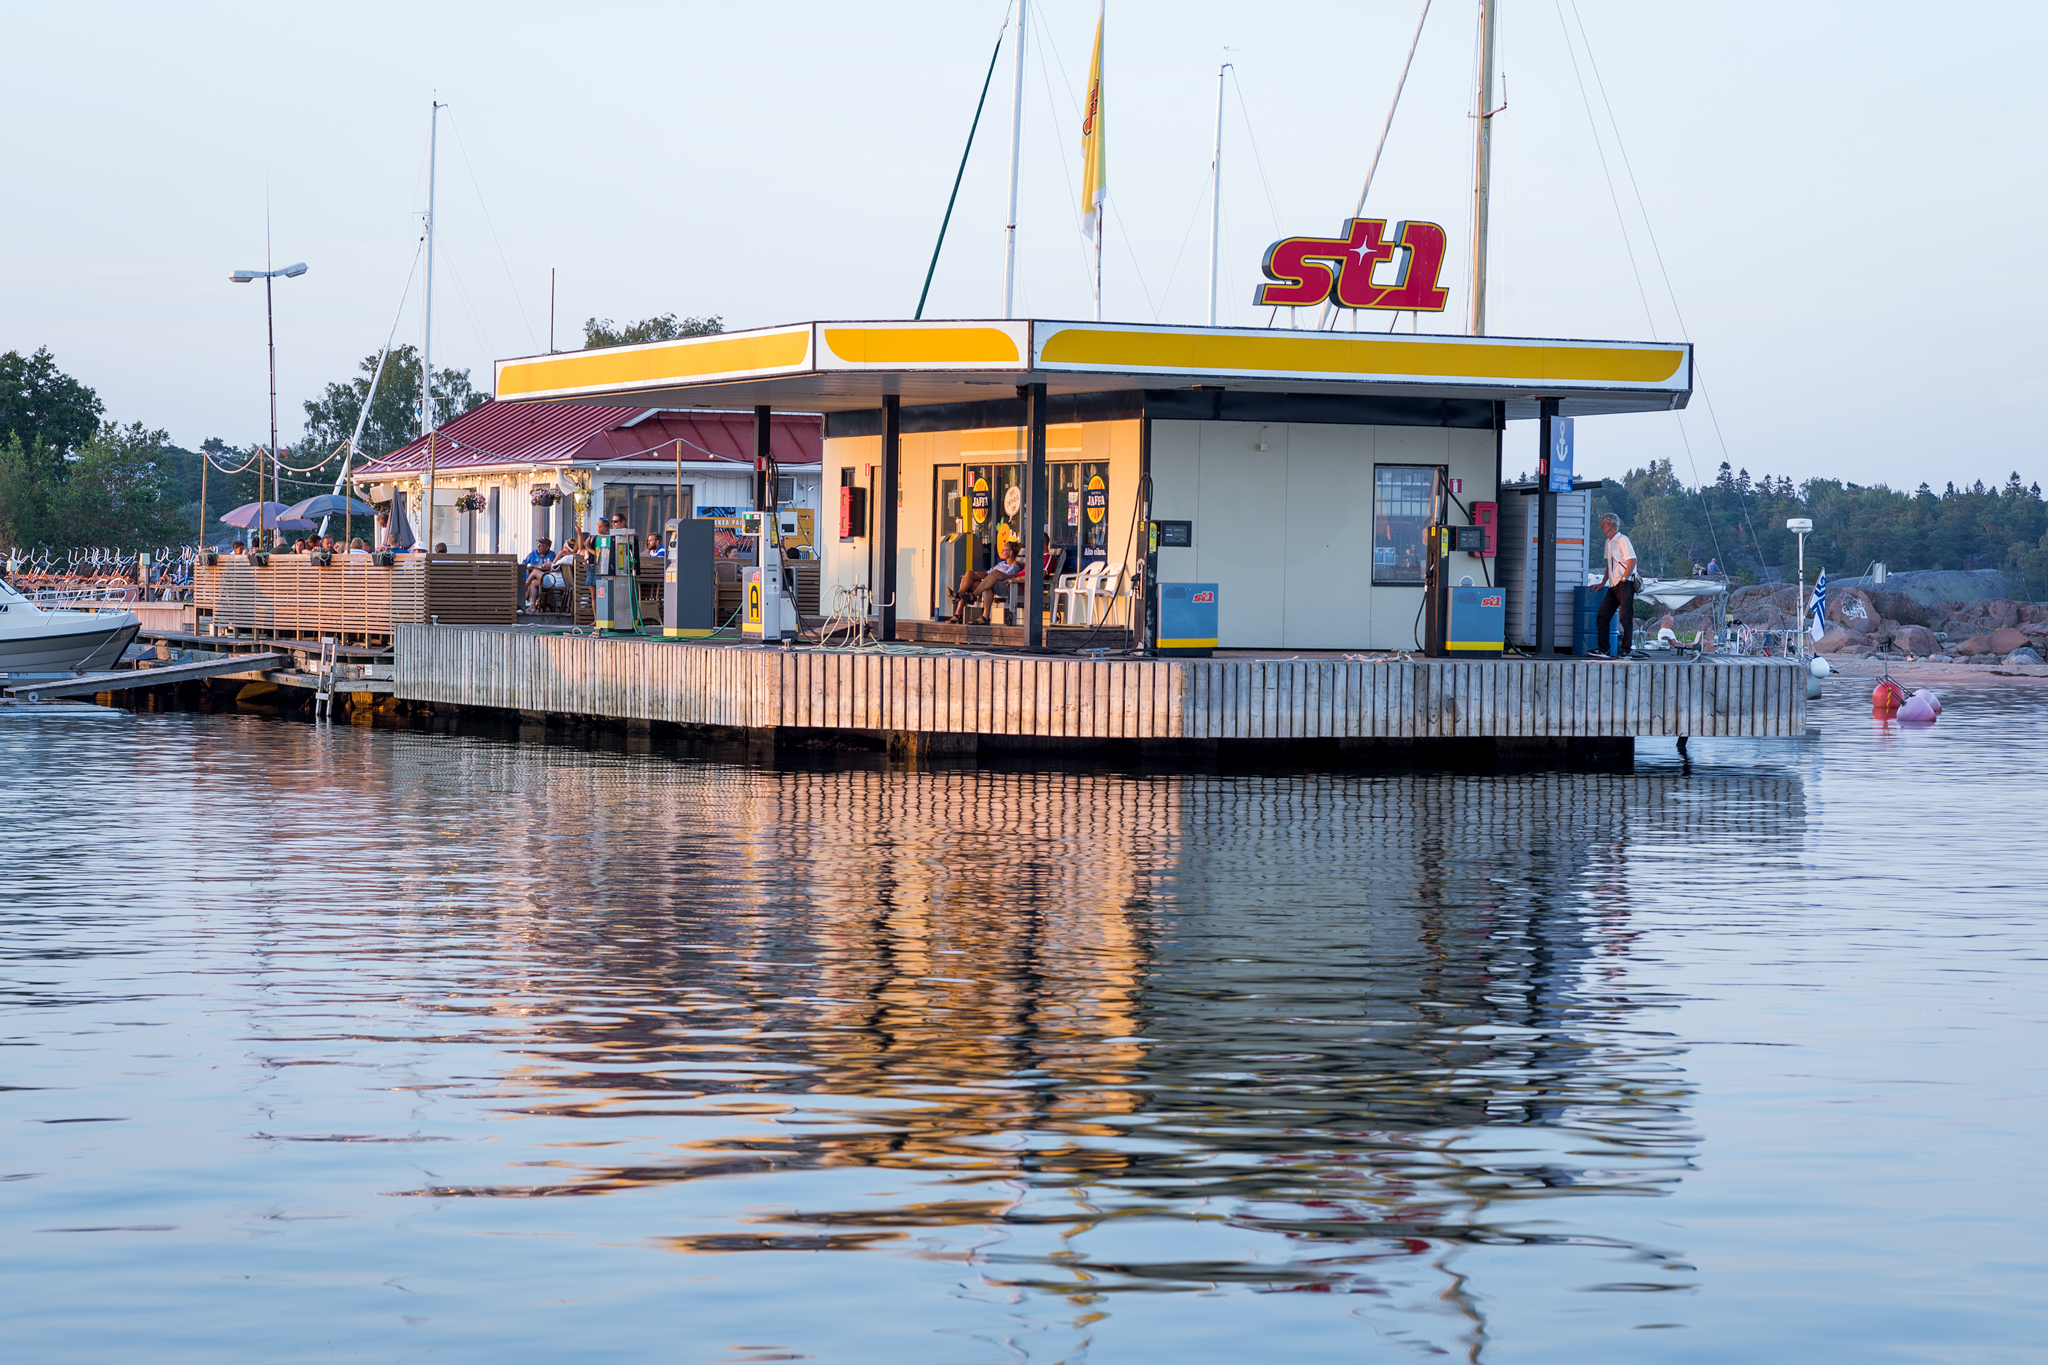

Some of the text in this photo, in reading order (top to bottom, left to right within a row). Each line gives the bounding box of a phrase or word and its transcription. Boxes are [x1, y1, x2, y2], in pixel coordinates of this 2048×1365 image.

[1253, 218, 1449, 312] st1
[972, 496, 989, 507] JAFFA
[1086, 495, 1106, 506] JAFFA
[750, 585, 759, 618] A
[1192, 591, 1215, 604] st1
[1481, 595, 1502, 608] st1
